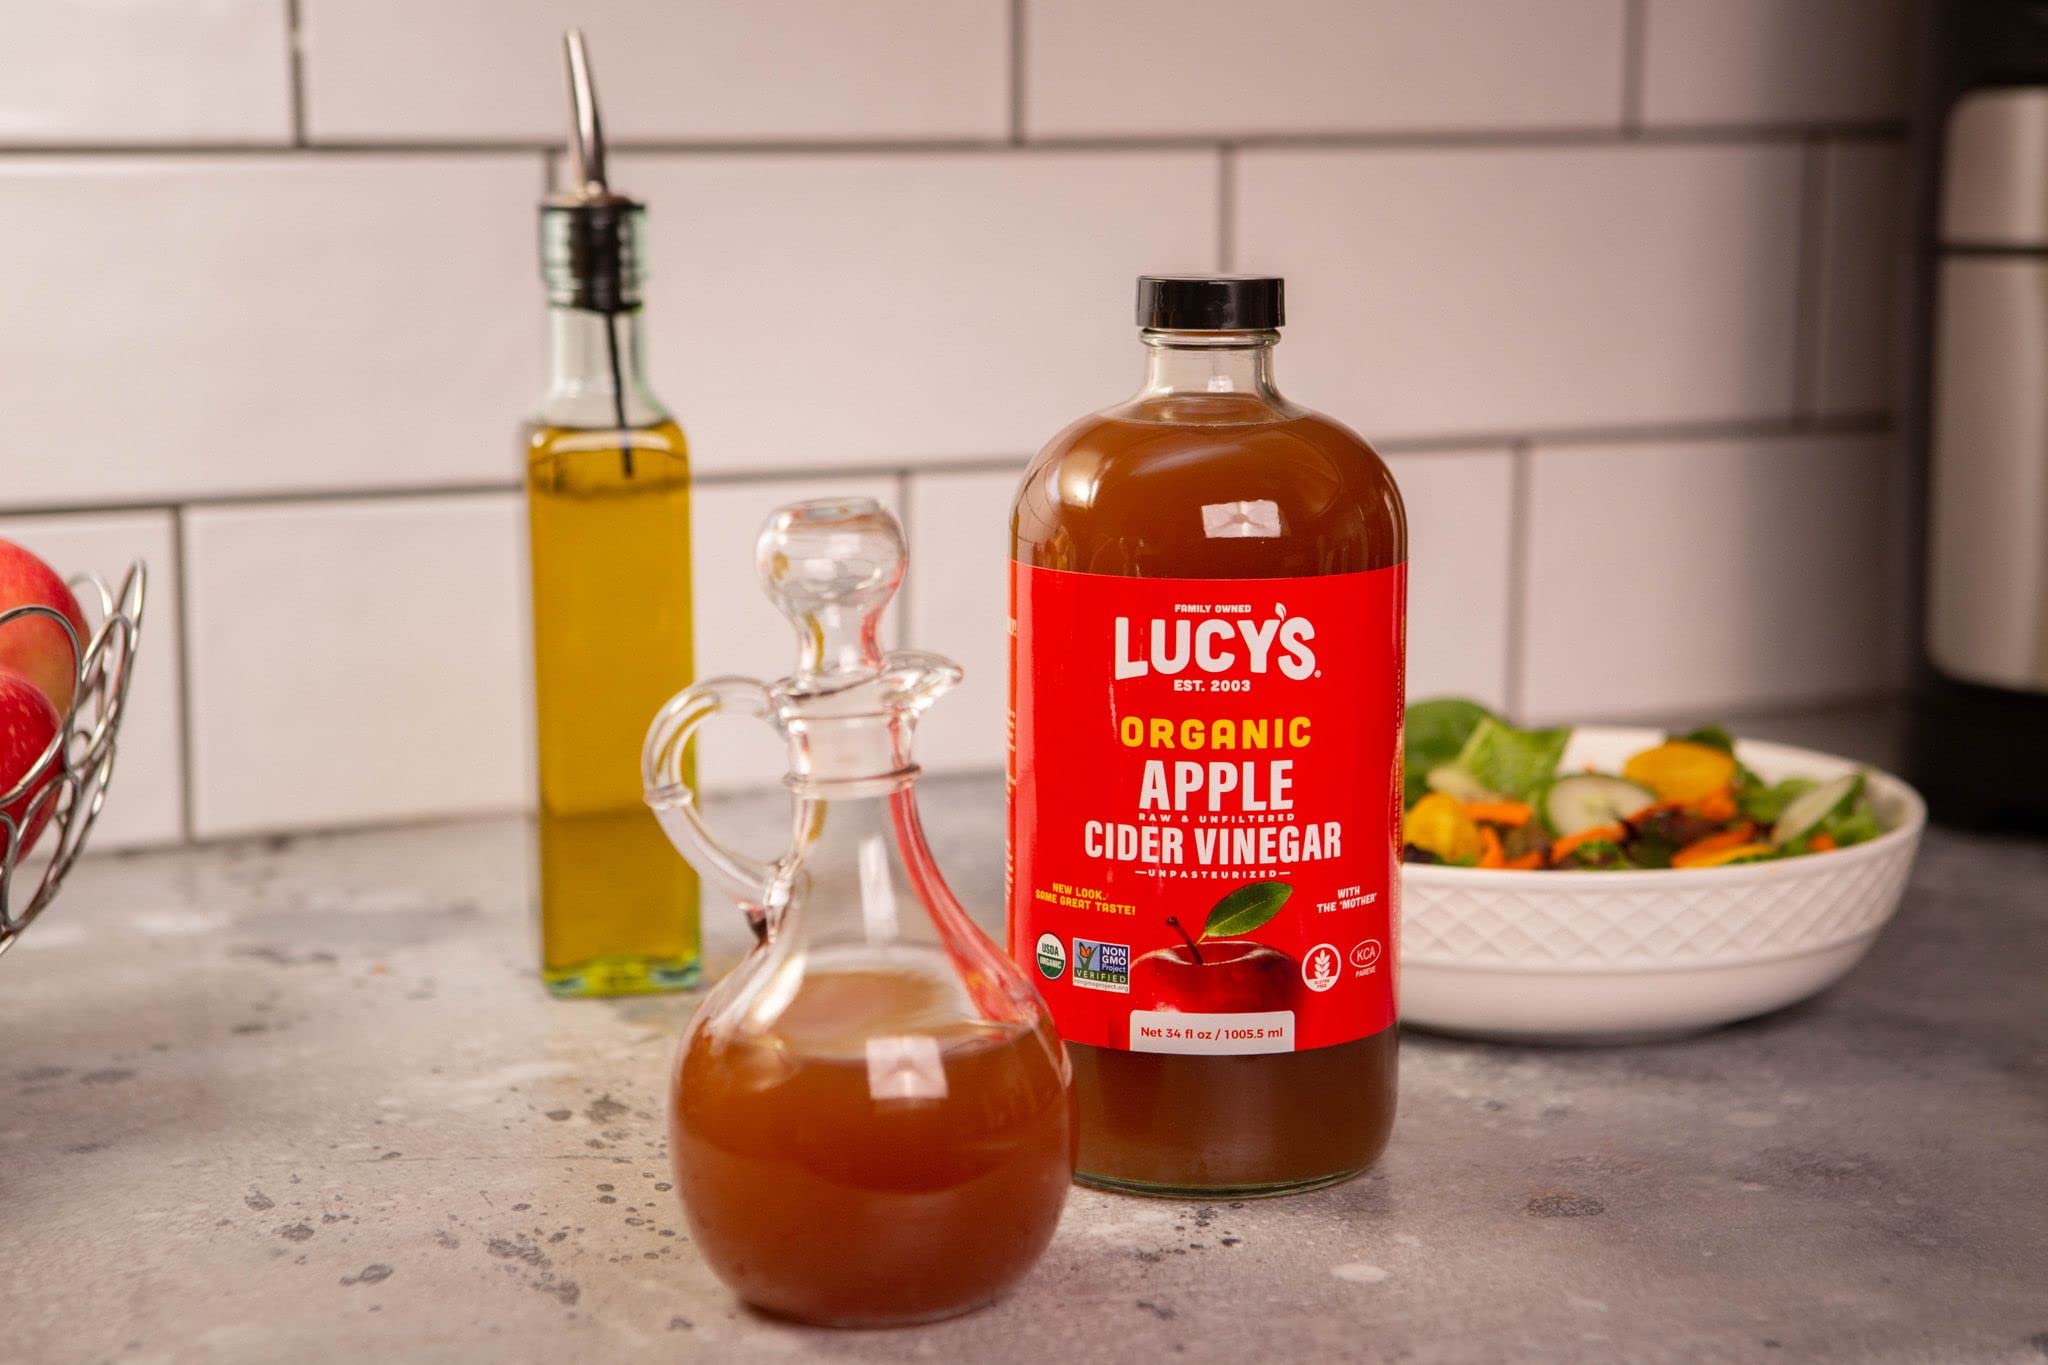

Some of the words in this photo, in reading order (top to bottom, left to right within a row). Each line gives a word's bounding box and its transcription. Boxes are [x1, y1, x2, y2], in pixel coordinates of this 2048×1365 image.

[1174, 604, 1212, 613] FAMILY
[1214, 604, 1252, 613] OWNED
[1173, 679, 1206, 692] EST.
[1210, 679, 1251, 692] 2003
[1120, 715, 1312, 750] ORGANIC
[1138, 759, 1294, 812] APPLE
[1138, 812, 1172, 823] RAW
[1181, 815, 1189, 823] &
[1199, 813, 1295, 823] UNFILTERED
[1084, 820, 1184, 865] CIDER
[1194, 821, 1342, 865] VINEGAR
[1147, 869, 1278, 879] UNPASTEURIZED
[1052, 882, 1072, 895] NEW
[1337, 885, 1361, 899] WITH
[1035, 889, 1058, 904] SAME
[1059, 896, 1091, 910] GREAT
[1095, 901, 1136, 915] TASTE!
[1316, 901, 1337, 913] THE
[1041, 942, 1059, 957] USDA
[1102, 946, 1126, 957] NON
[1356, 945, 1376, 962] KCA
[1101, 955, 1127, 966] GMO
[1101, 963, 1127, 974] Project
[1076, 969, 1127, 983] VERIFIED
[1140, 1027, 1162, 1038] Net
[1166, 1028, 1181, 1039] 34
[1185, 1028, 1193, 1039] fl
[1197, 1031, 1212, 1040] oz
[1214, 1028, 1221, 1041] /
[1225, 1028, 1264, 1040] 1005.5
[1267, 1027, 1283, 1038] ml
